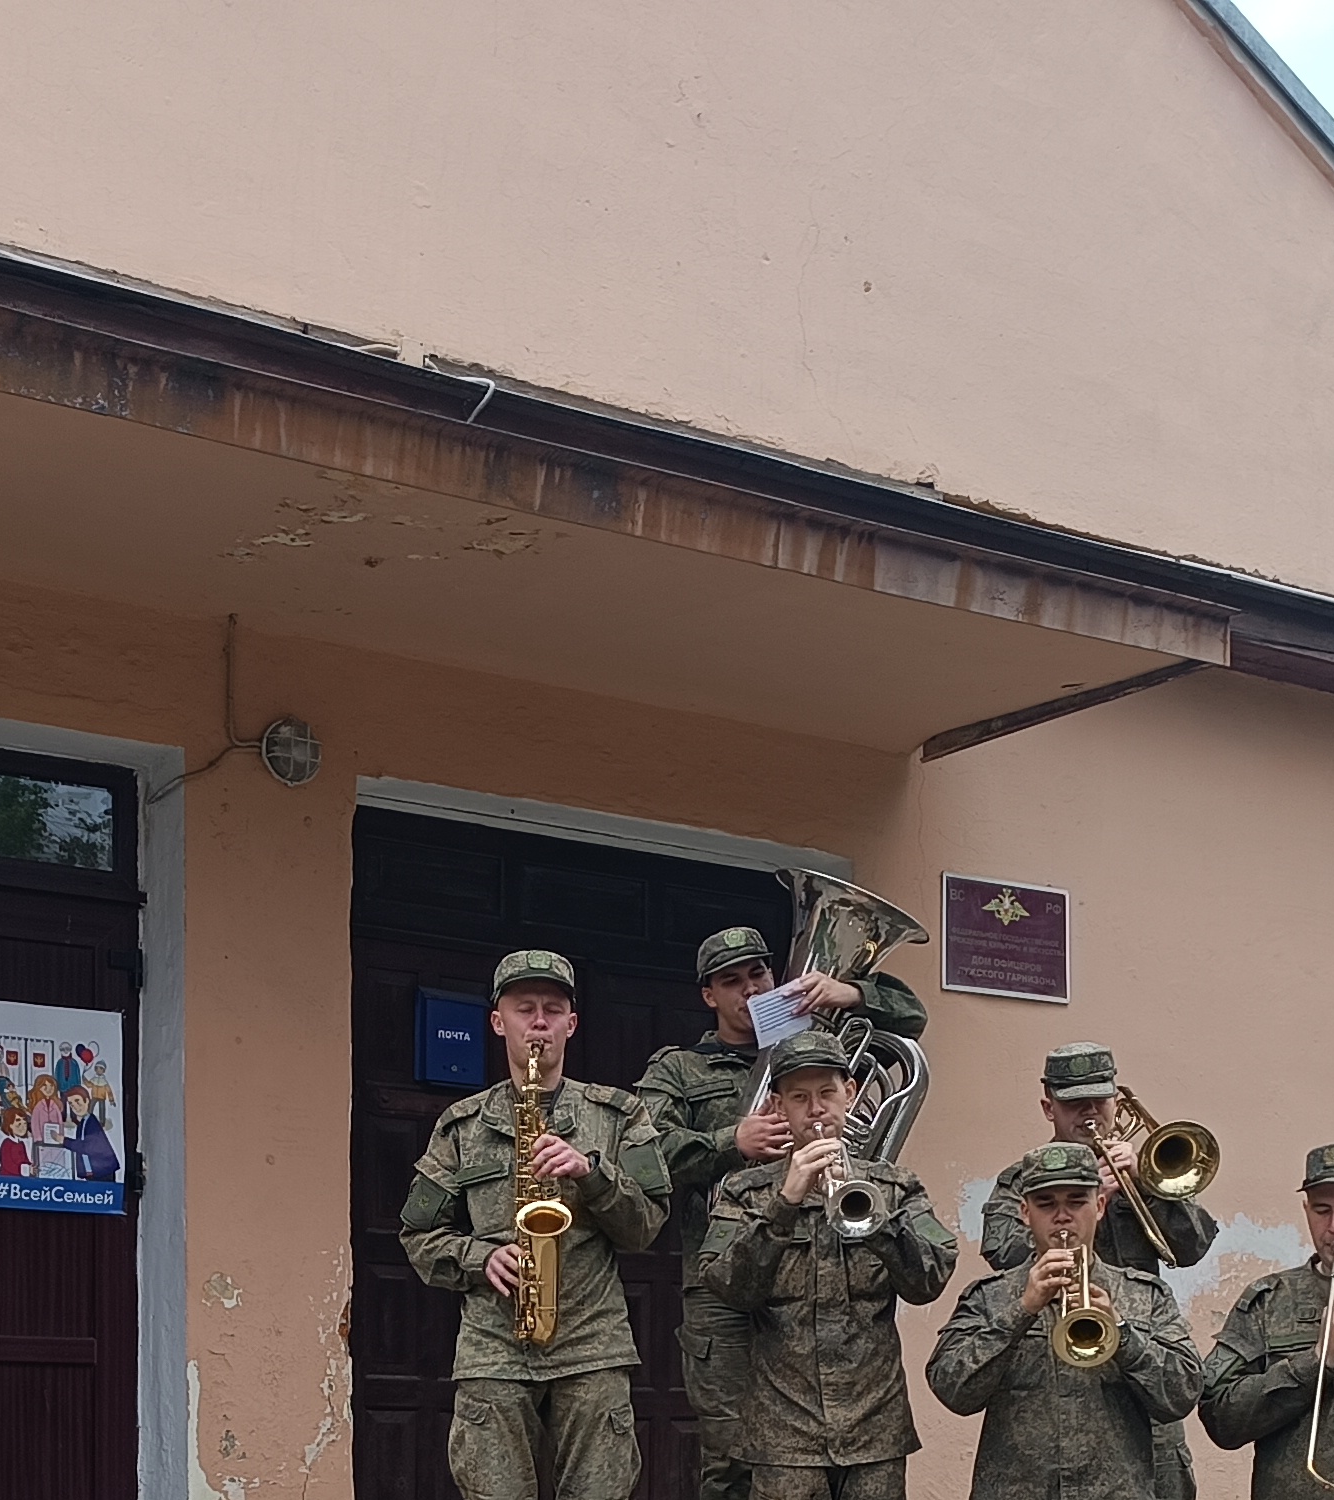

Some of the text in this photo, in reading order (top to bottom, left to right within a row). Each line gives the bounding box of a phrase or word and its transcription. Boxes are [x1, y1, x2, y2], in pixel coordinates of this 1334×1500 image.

[949, 888, 965, 901] ВС
[1046, 903, 1062, 914] РФ
[971, 955, 1042, 972] ДОМ ОФИЦЕРОВ
[437, 1029, 471, 1041] ПОЧТА
